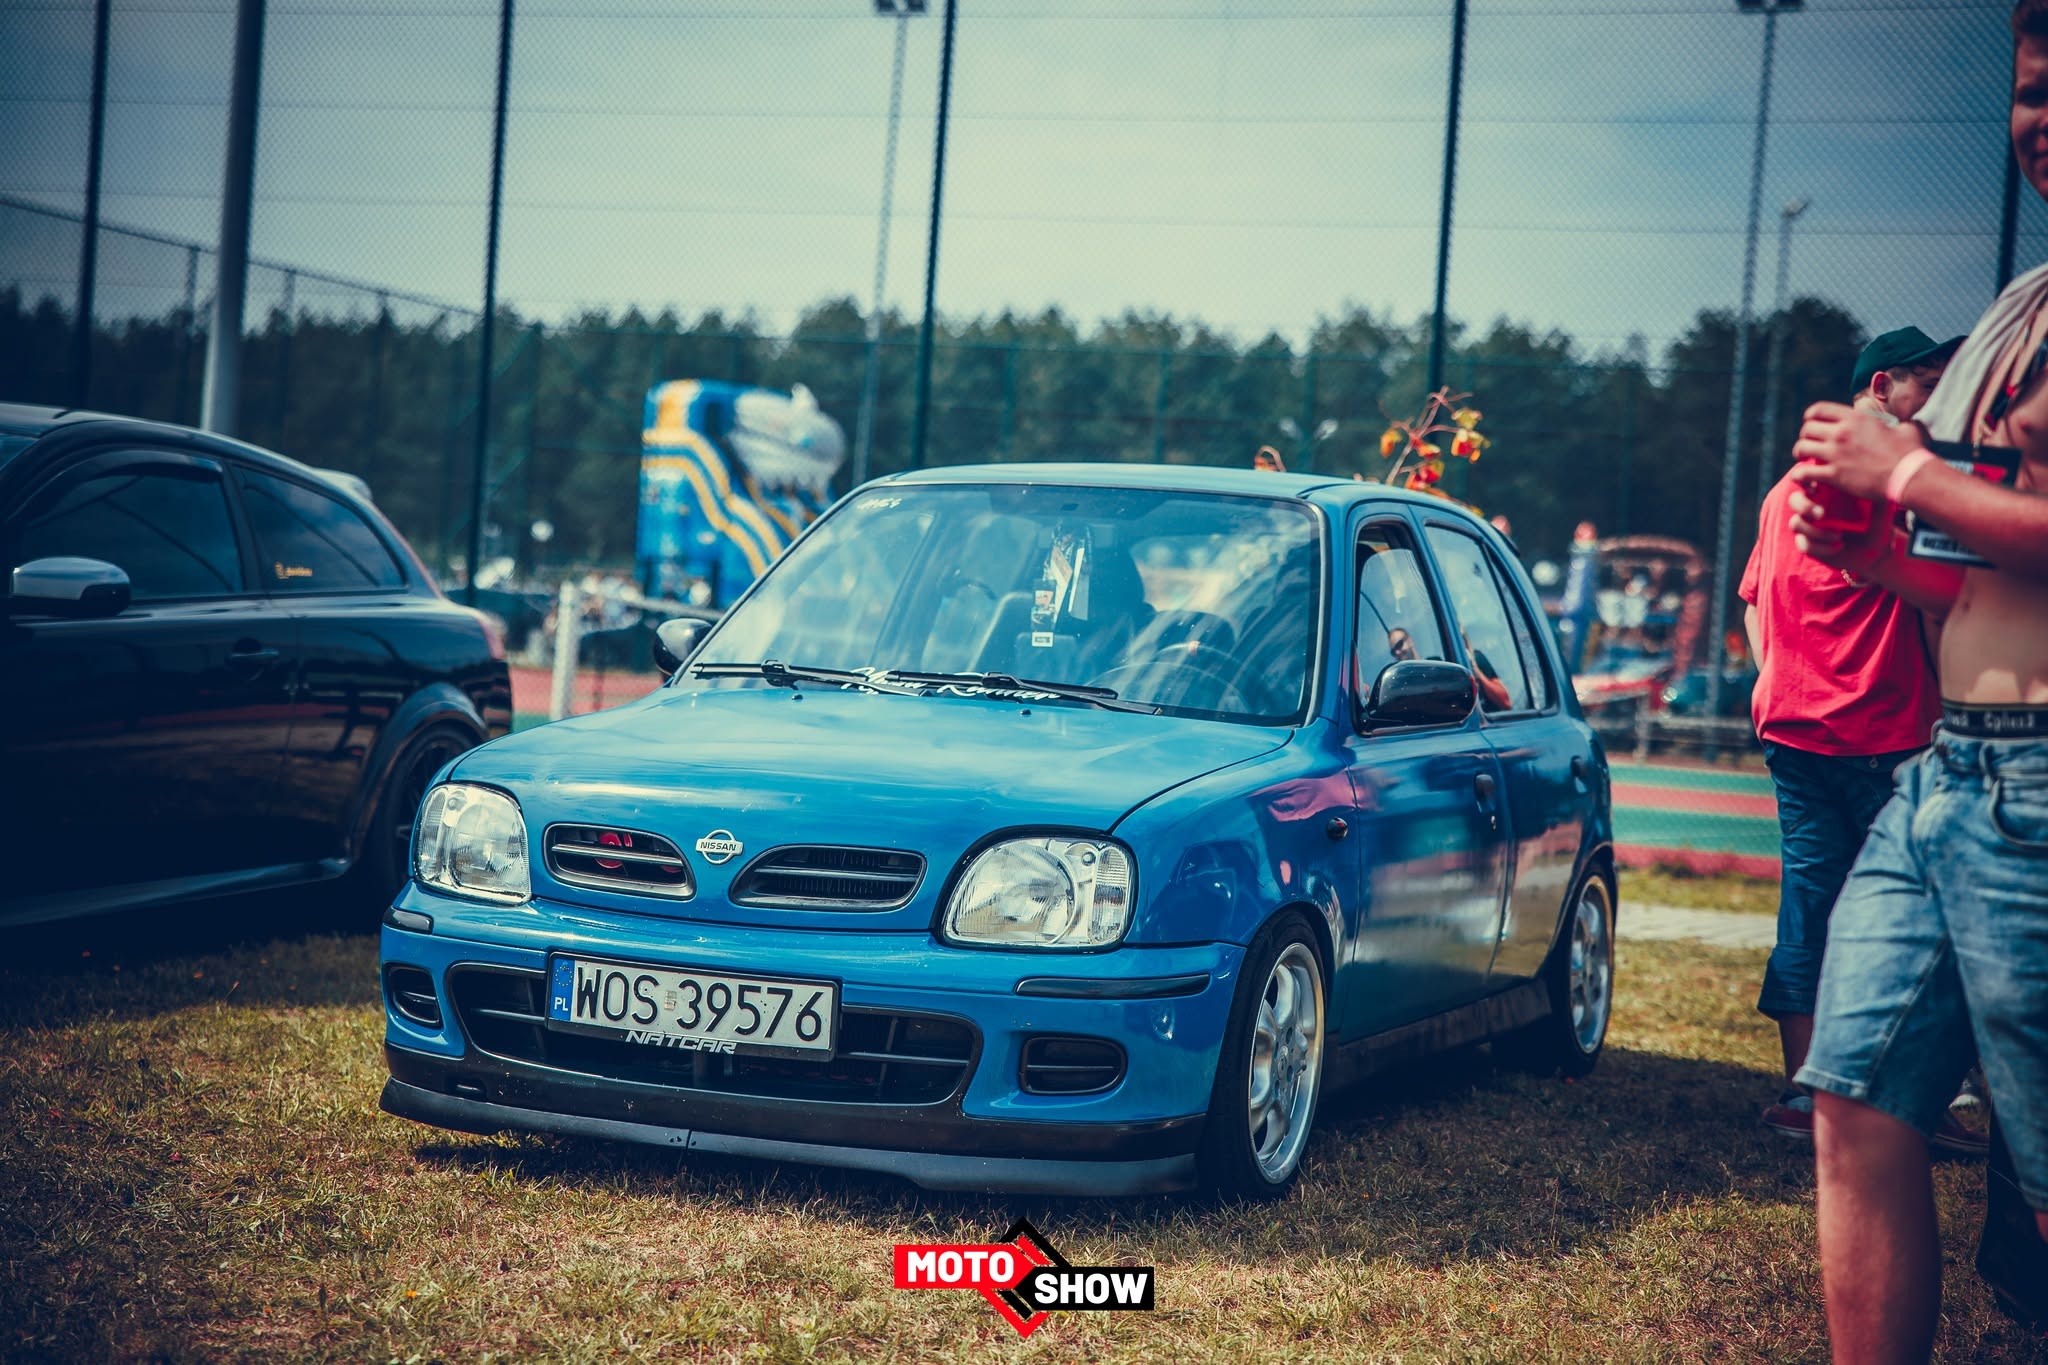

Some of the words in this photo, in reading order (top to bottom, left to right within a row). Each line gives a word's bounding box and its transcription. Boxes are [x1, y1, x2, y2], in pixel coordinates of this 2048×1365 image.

[700, 841, 737, 851] NISSAN
[554, 996, 569, 1011] PL
[576, 966, 660, 1025] WOS
[676, 979, 824, 1042] 39576
[625, 1030, 737, 1055] NATCAR
